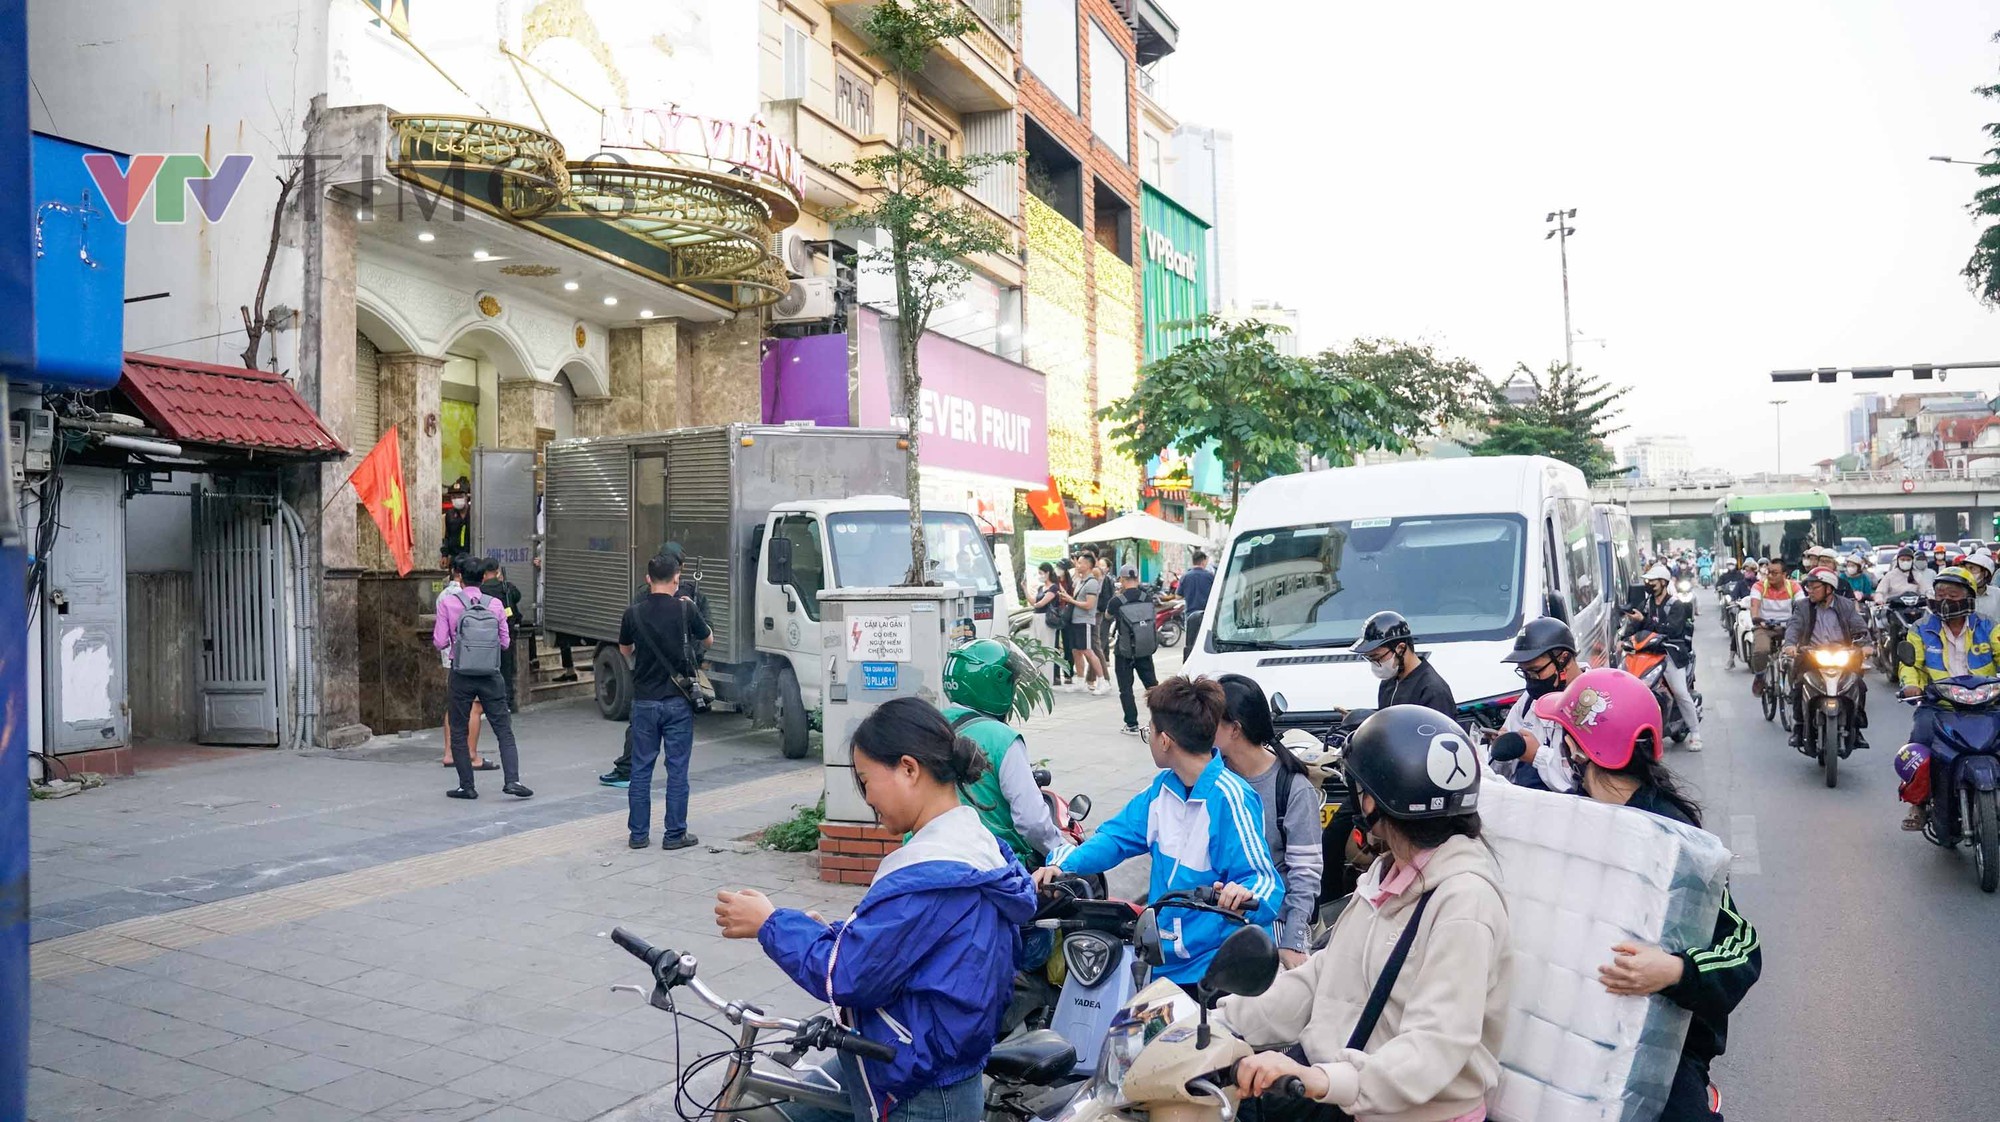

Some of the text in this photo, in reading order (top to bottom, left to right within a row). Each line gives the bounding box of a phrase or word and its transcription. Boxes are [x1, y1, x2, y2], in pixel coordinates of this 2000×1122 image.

[1144, 225, 1197, 284] VPBank
[982, 404, 1032, 455] FRUIT
[871, 676, 888, 686] PILLAR
[1074, 998, 1101, 1009] YADEA
